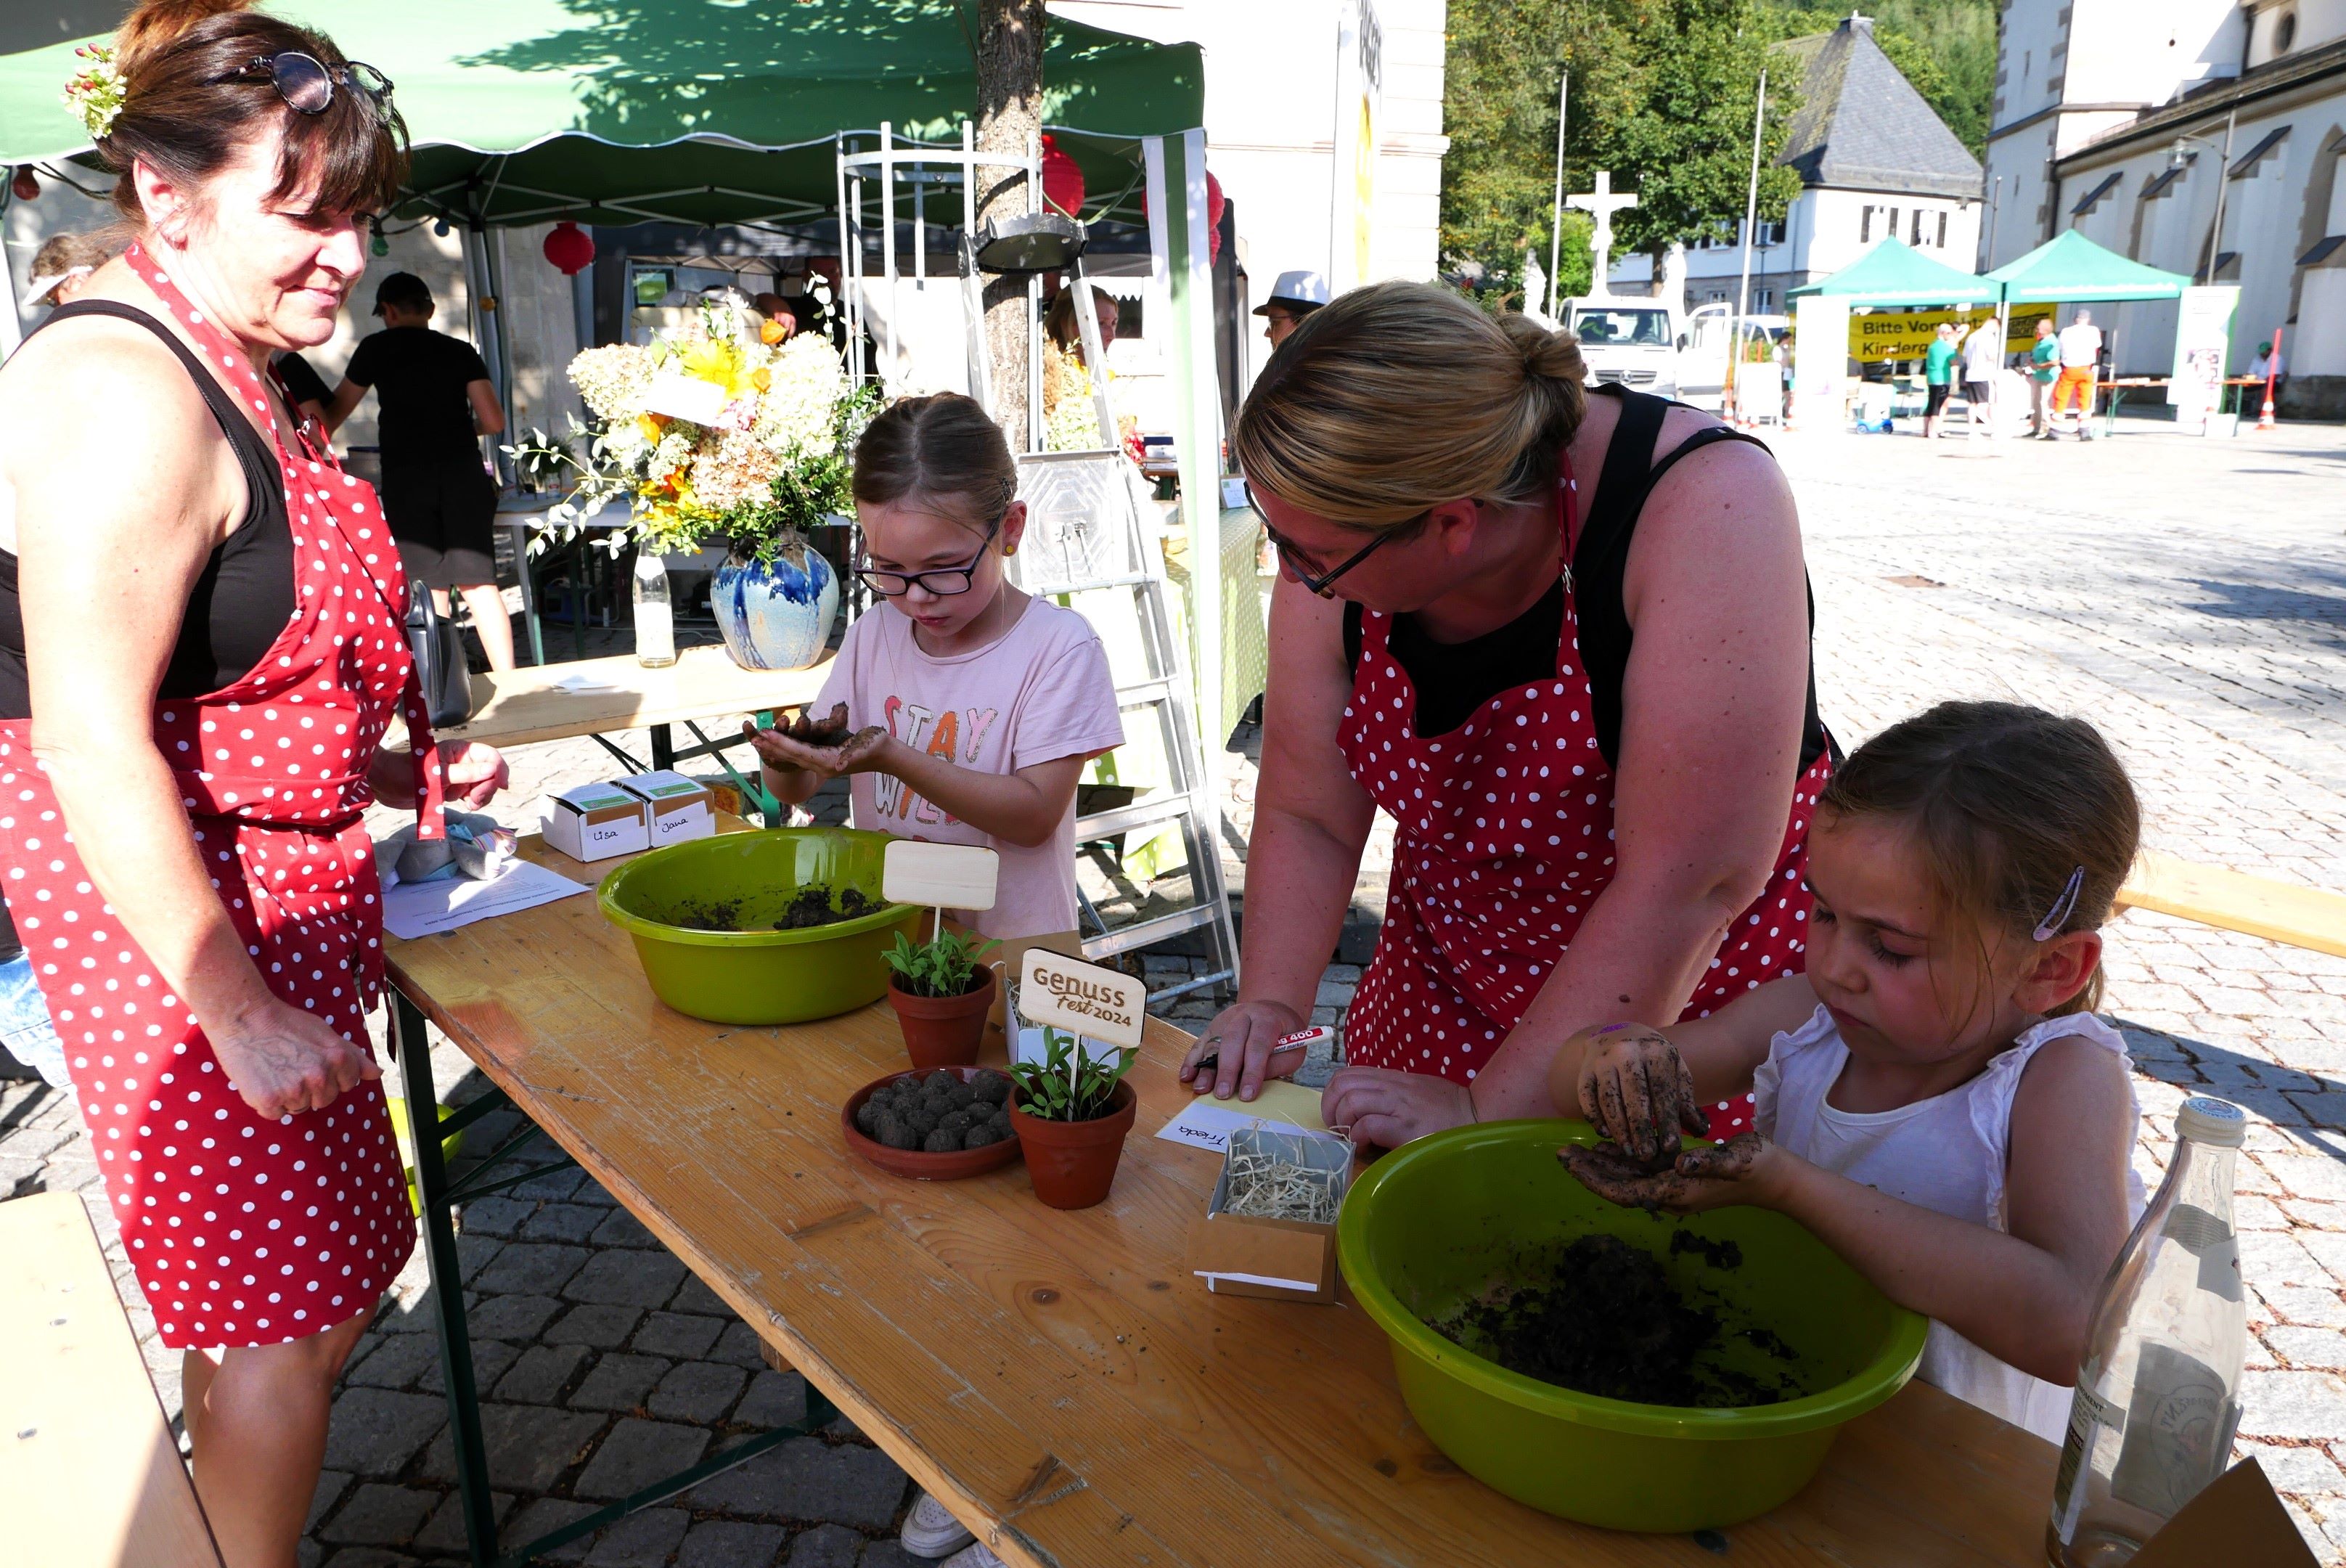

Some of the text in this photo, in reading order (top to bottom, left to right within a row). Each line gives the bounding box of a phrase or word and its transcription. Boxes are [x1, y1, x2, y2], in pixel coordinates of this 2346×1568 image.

[1863, 322, 1902, 335] Bitte
[884, 695, 998, 764] STAY
[874, 771, 964, 826] WIL
[661, 818, 689, 833] Jana
[593, 830, 618, 841] Lisa
[1093, 1006, 1132, 1027] 2024
[1290, 1029, 1314, 1040] 400
[1286, 1041, 1305, 1050] marker
[1178, 1125, 1226, 1146] Frieda
